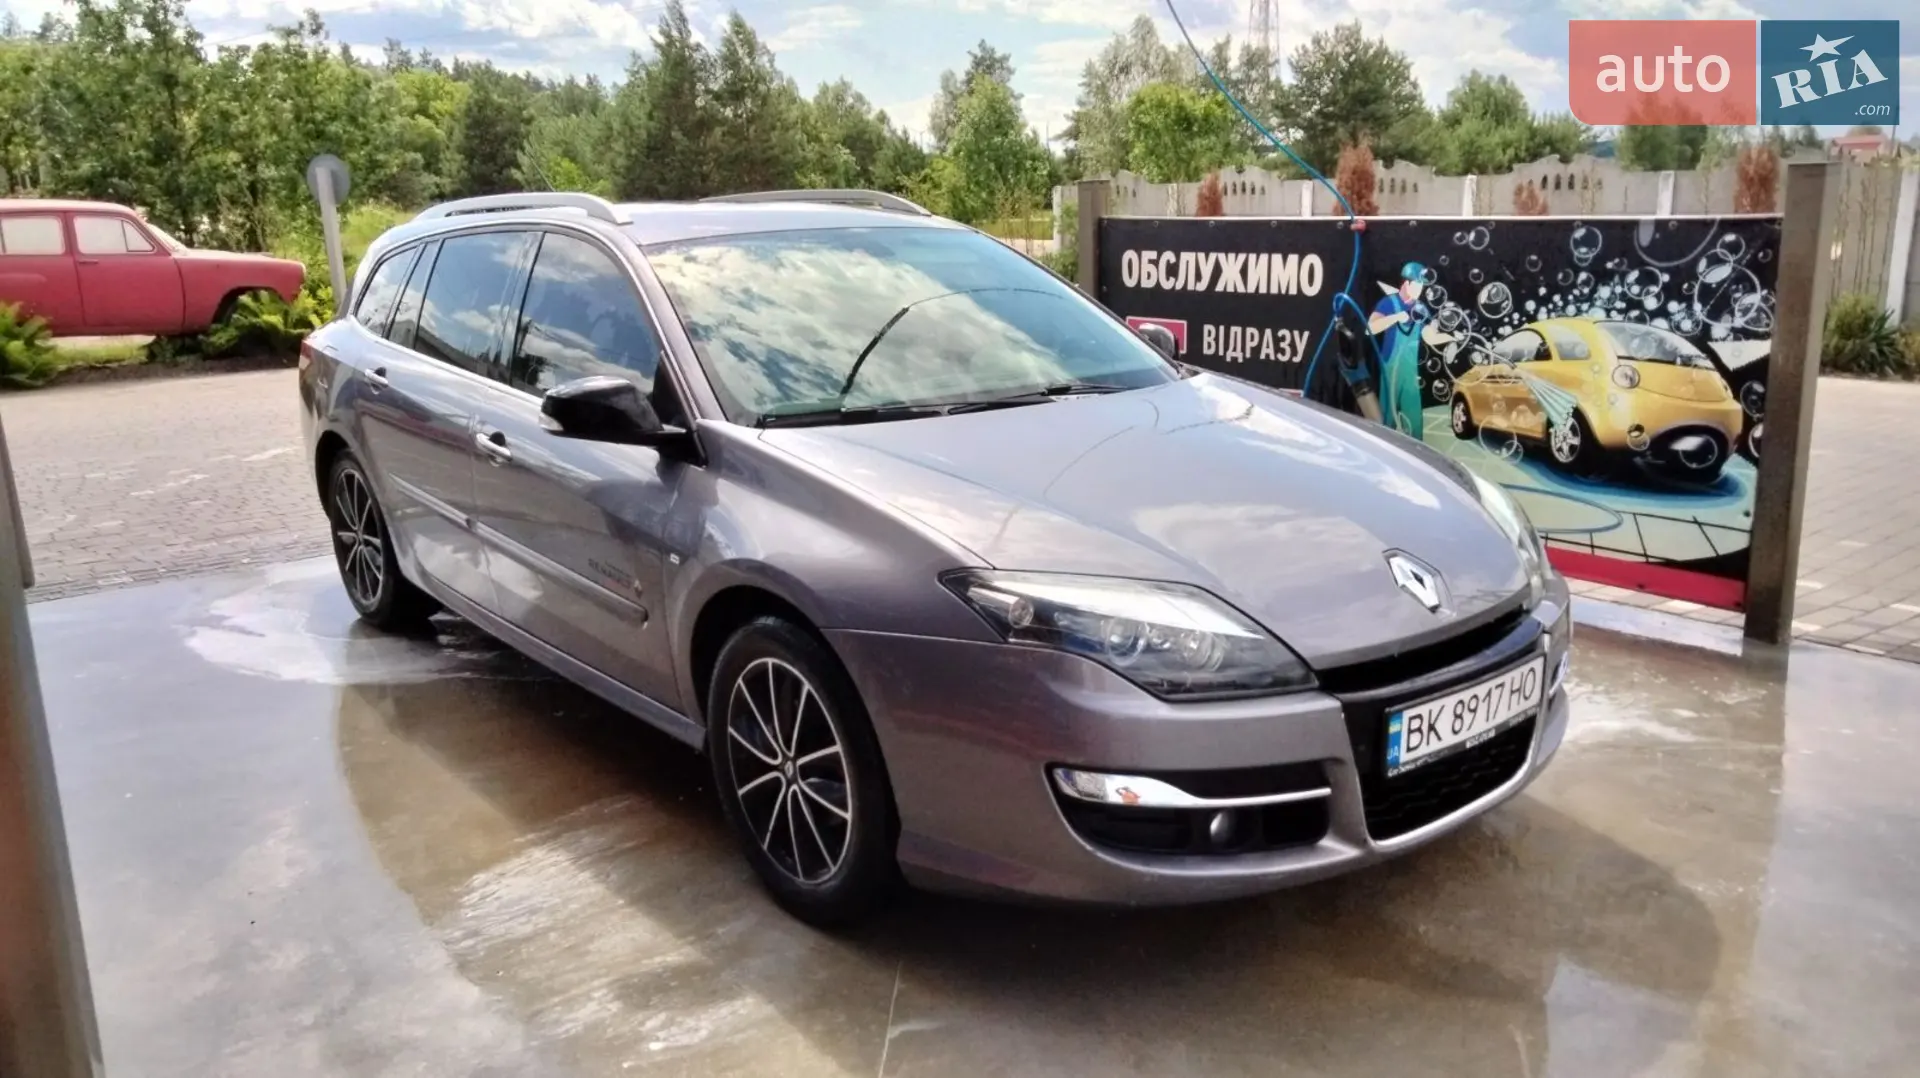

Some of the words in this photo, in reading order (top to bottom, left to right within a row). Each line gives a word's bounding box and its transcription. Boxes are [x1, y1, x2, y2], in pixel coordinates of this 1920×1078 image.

[1121, 249, 1324, 297] ОБСЛУЖИМО
[1202, 323, 1310, 363] ВІДРАЗУ
[1405, 705, 1446, 753] BK
[1451, 682, 1506, 736] 8917
[1507, 667, 1537, 711] HO
